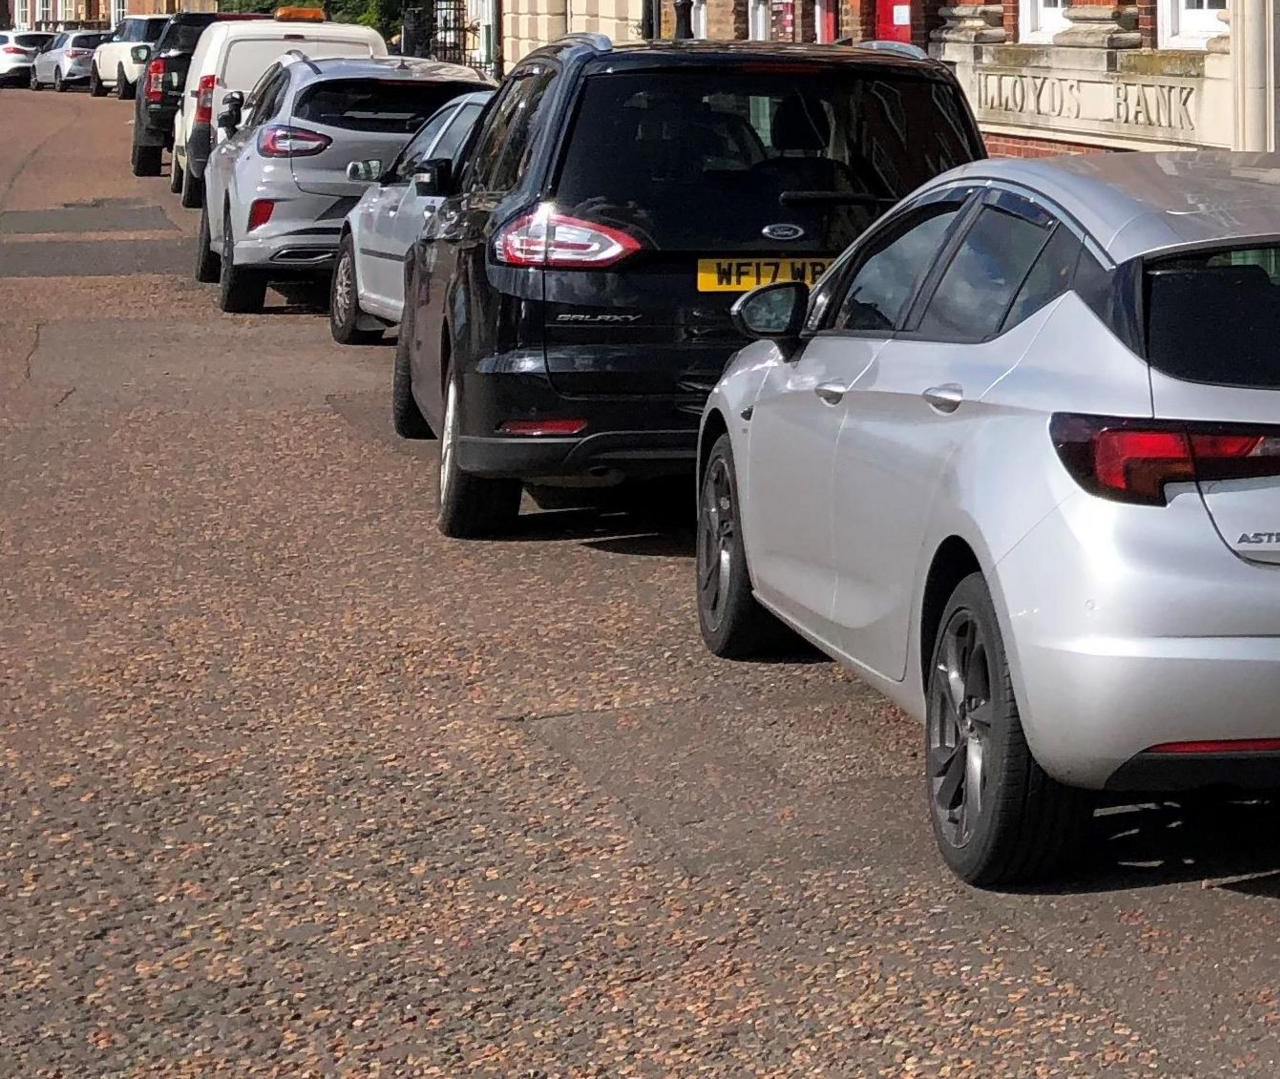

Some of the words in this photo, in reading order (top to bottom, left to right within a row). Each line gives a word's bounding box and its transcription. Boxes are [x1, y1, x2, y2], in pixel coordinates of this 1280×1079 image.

[982, 72, 1080, 119] LLOYDS
[1112, 80, 1195, 131] BANK
[715, 261, 780, 286] WF17
